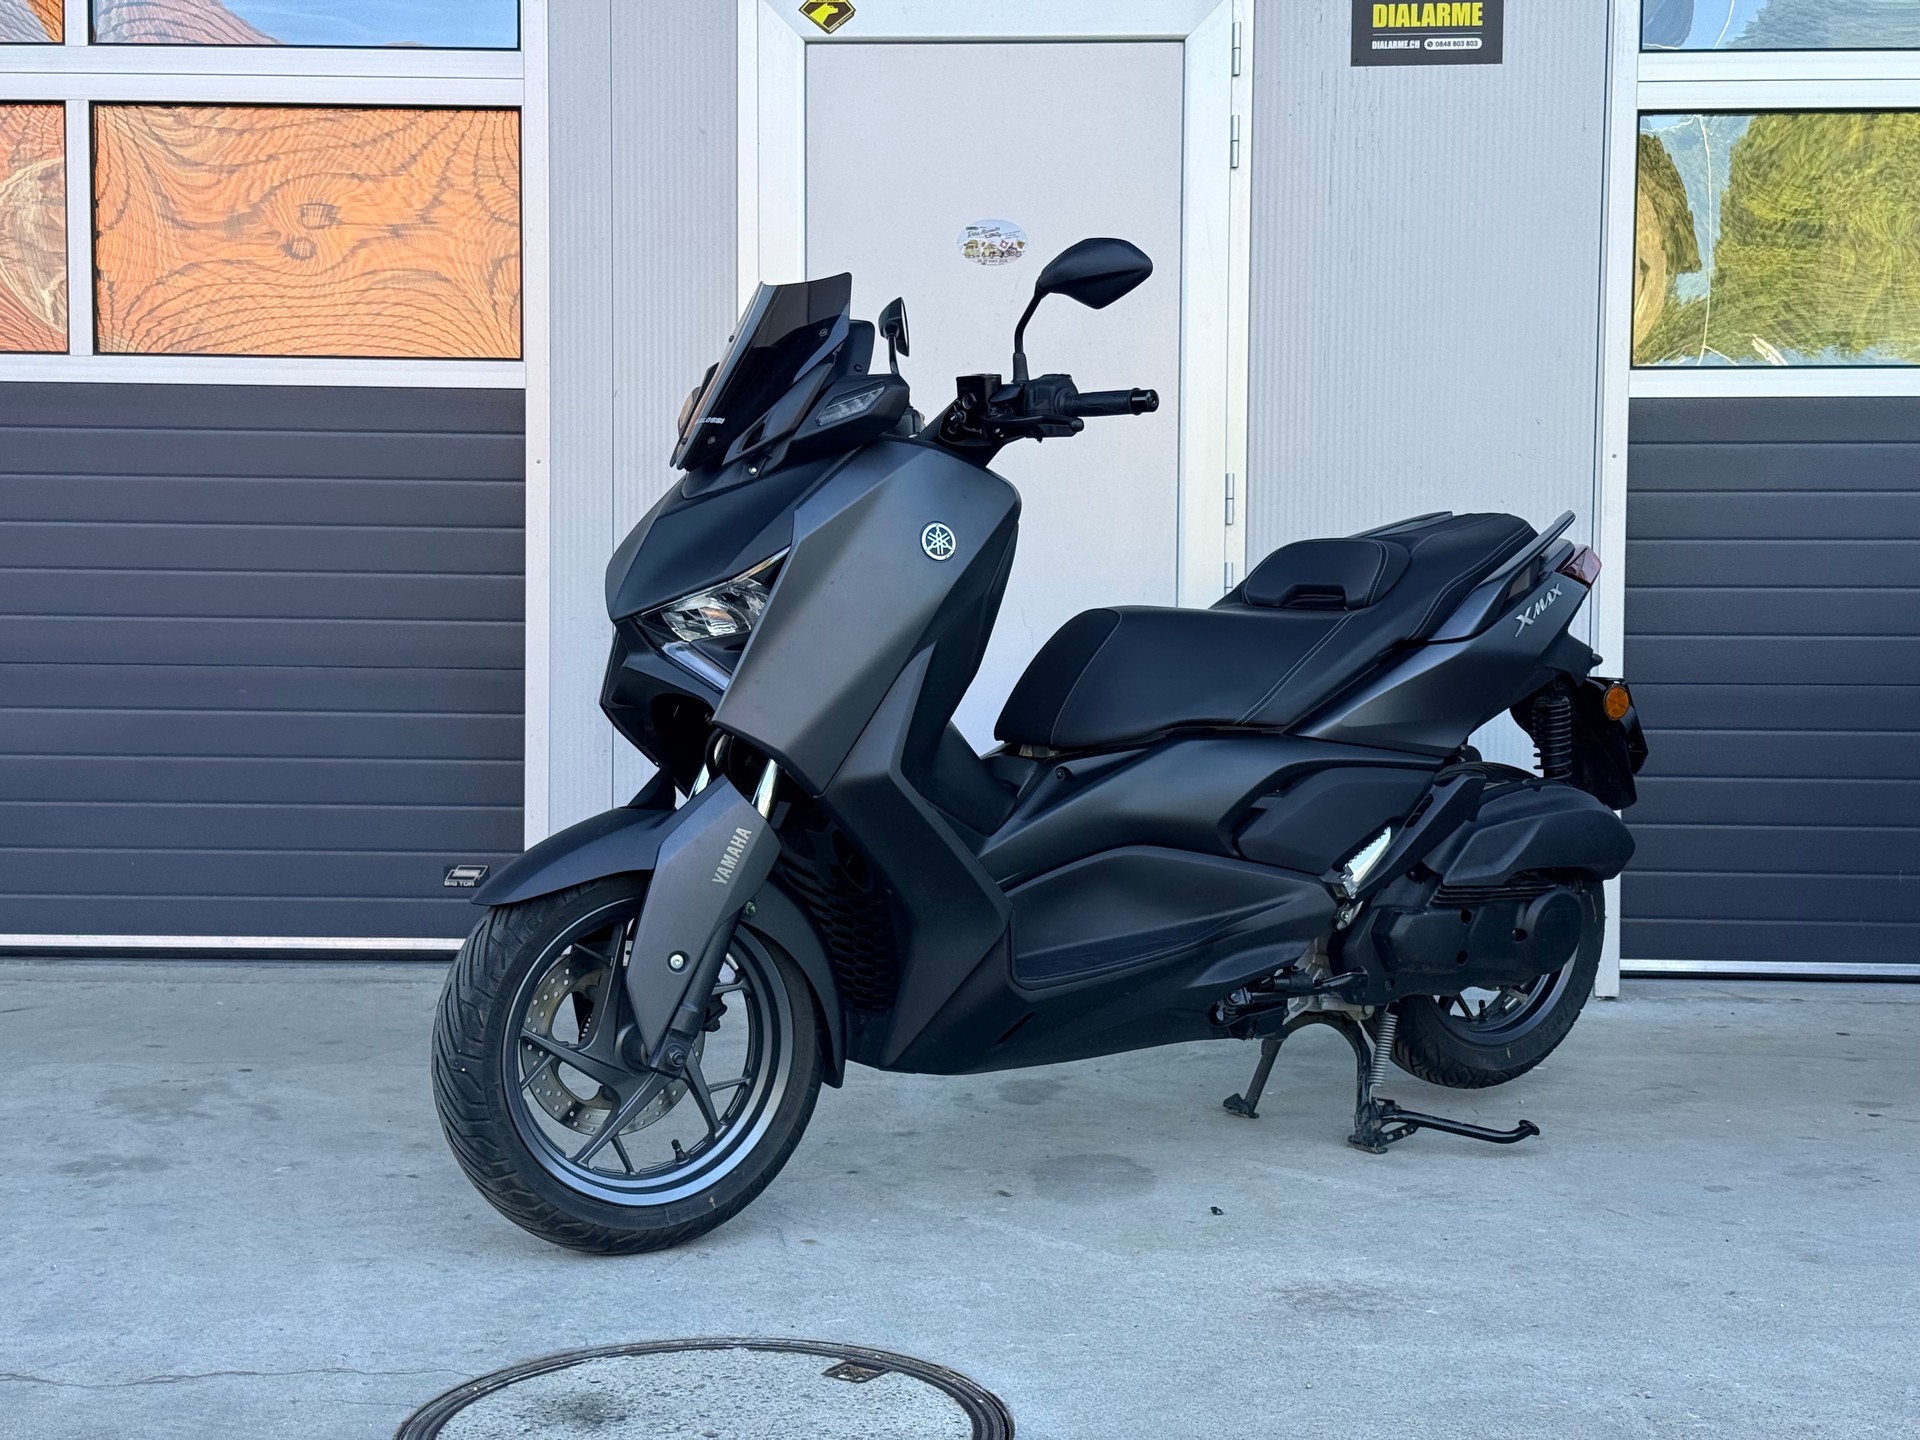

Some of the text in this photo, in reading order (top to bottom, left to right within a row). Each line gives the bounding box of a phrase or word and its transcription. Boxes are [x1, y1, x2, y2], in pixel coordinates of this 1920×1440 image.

[1372, 2, 1483, 28] DIALARME
[1371, 40, 1420, 50] DIALARME.CH
[1435, 40, 1451, 48] 0848
[1453, 40, 1465, 48] 803
[711, 827, 753, 885] YAMAHA
